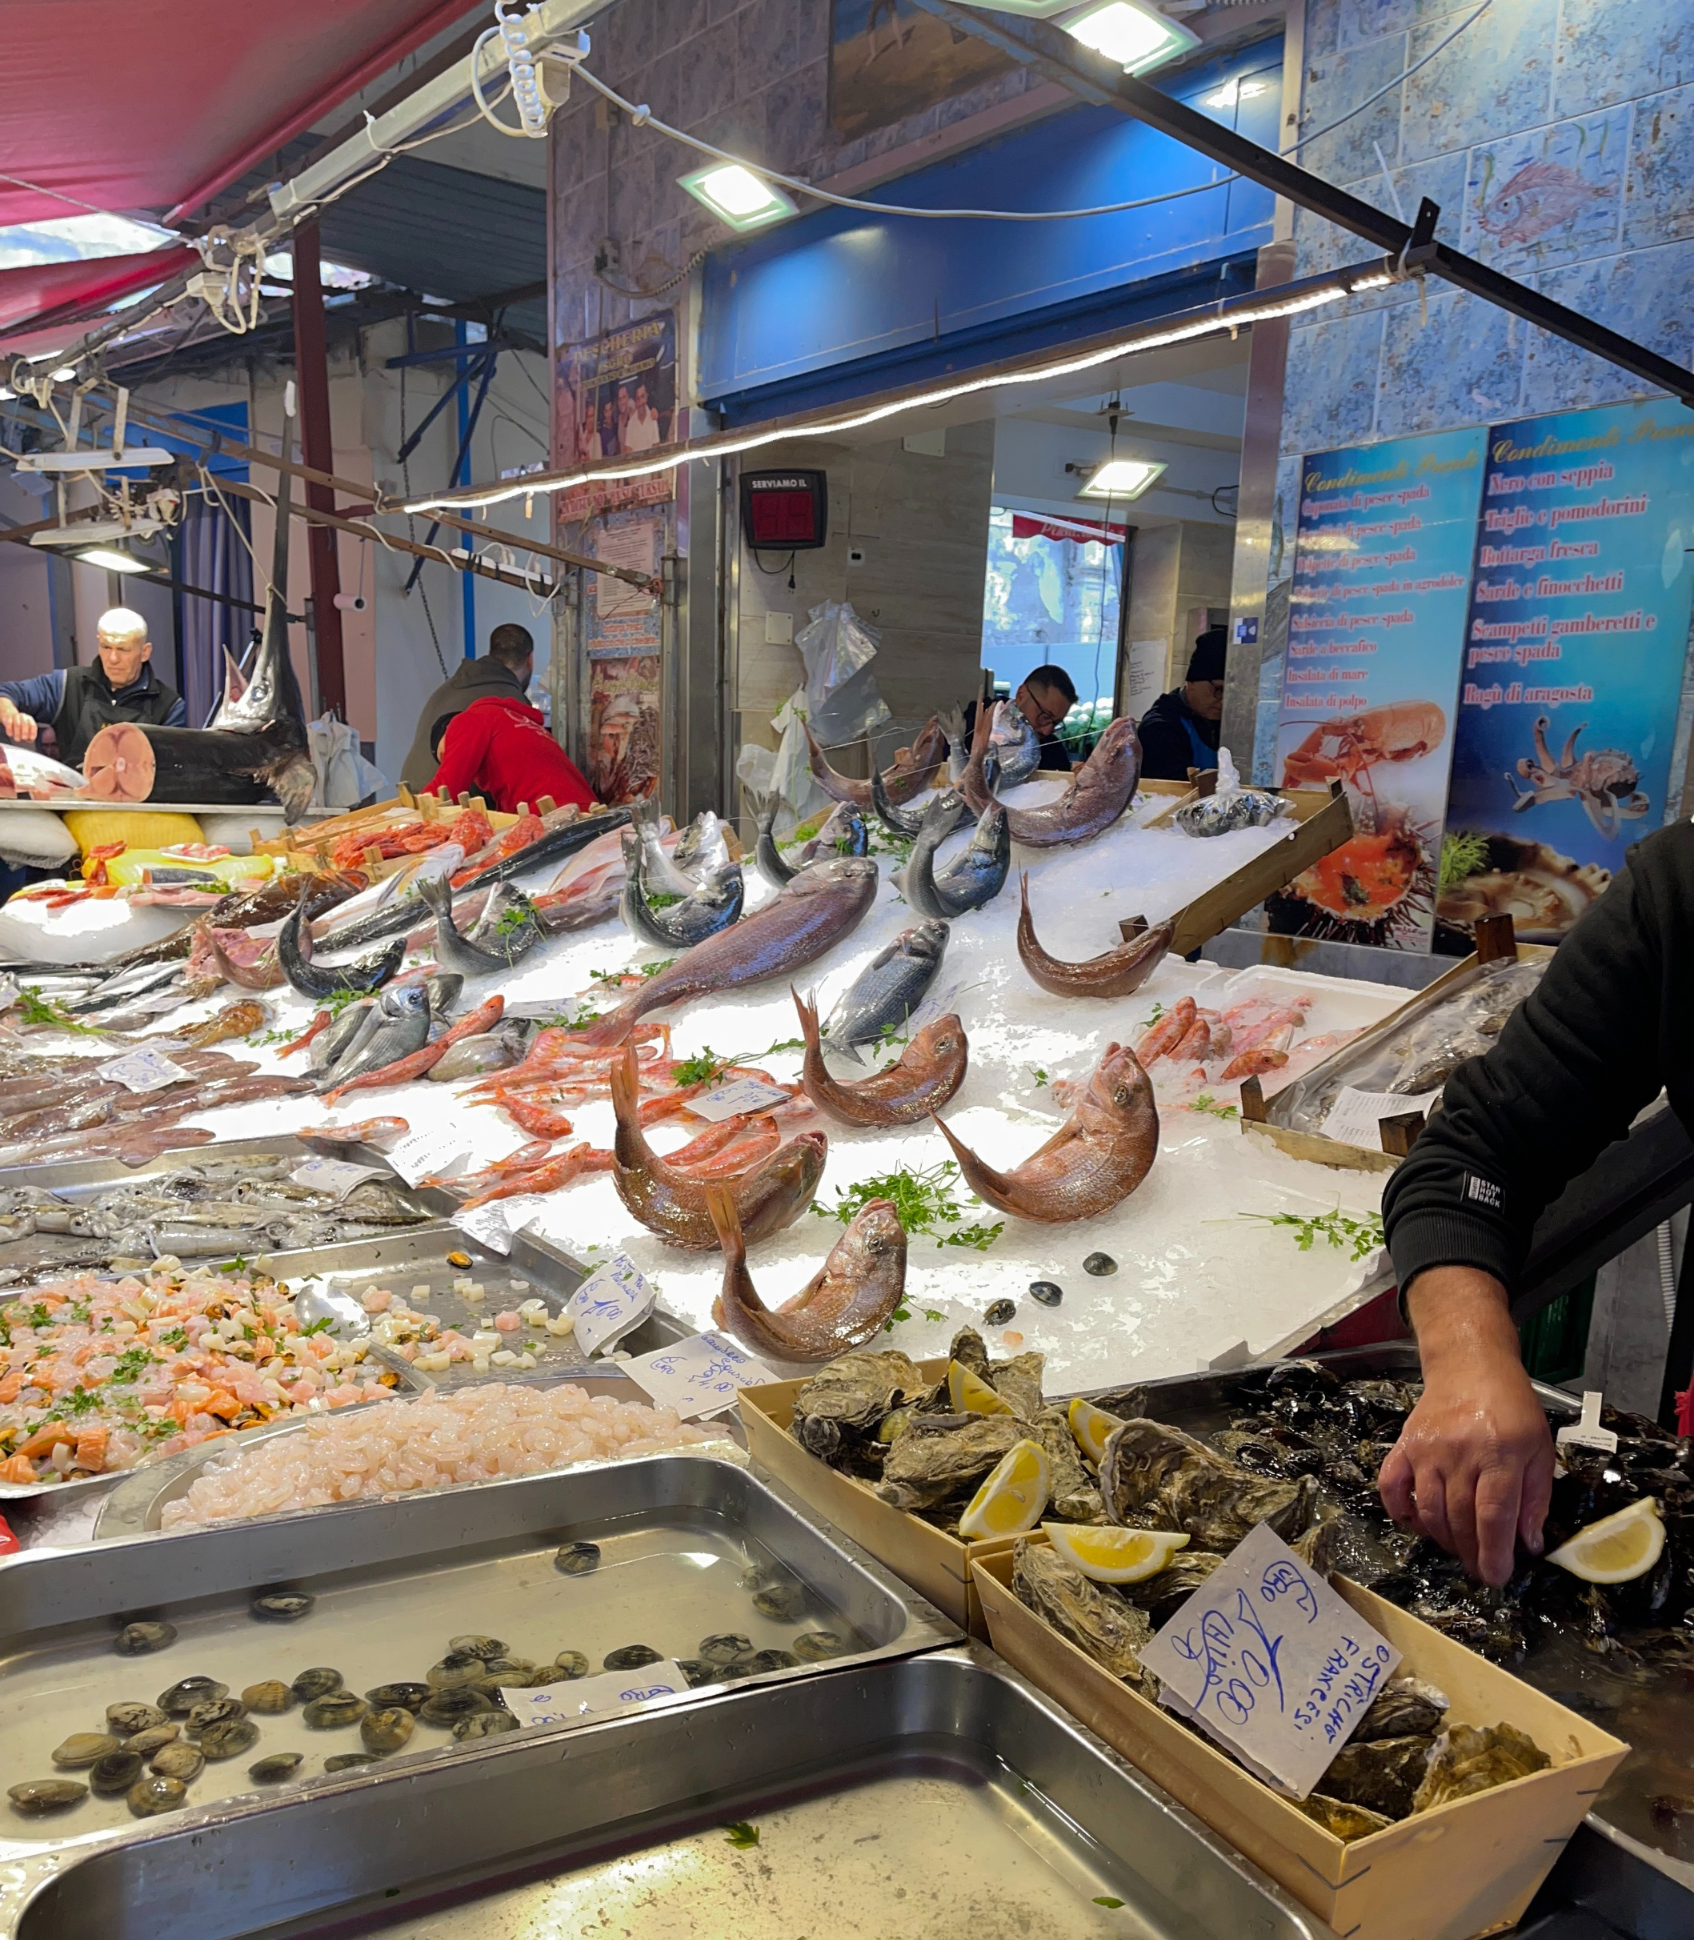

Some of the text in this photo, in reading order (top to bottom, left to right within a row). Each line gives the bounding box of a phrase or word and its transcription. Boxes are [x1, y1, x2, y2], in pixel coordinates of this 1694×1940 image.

[1493, 426, 1621, 463] Condimenti
[752, 479, 807, 489] SERVIAMO IL
[1305, 460, 1407, 492] Condimenti
[1488, 461, 1614, 495] Nero con seppia
[1302, 484, 1430, 518] Caponata di pesce spada
[1486, 494, 1647, 533] Triglie e pomodorini
[1345, 522, 1354, 537] di
[1356, 525, 1385, 540] pesce
[1389, 515, 1421, 537] spada
[1338, 553, 1349, 568] di
[1351, 556, 1380, 572] pesce
[1384, 546, 1416, 567] spada
[1480, 540, 1599, 567] Bottarga fresca
[1332, 583, 1341, 597] di
[1343, 587, 1369, 600] pesce
[1372, 579, 1400, 596] spada
[1402, 580, 1413, 591] in
[1415, 574, 1465, 593] agrodolce
[1476, 572, 1624, 601] Sarde e finocchetti
[1337, 612, 1347, 626] di
[1349, 615, 1379, 630] pesce
[1381, 609, 1414, 627] spada
[1471, 611, 1656, 642] Scampetti gamberetti e
[1290, 639, 1377, 657] Sarde a beccafico
[1468, 641, 1561, 667] pesce spada
[1287, 668, 1368, 682] Insalata di mare
[1285, 694, 1367, 710] Insalata di polpo
[1464, 683, 1593, 708] Ragù di aragosta
